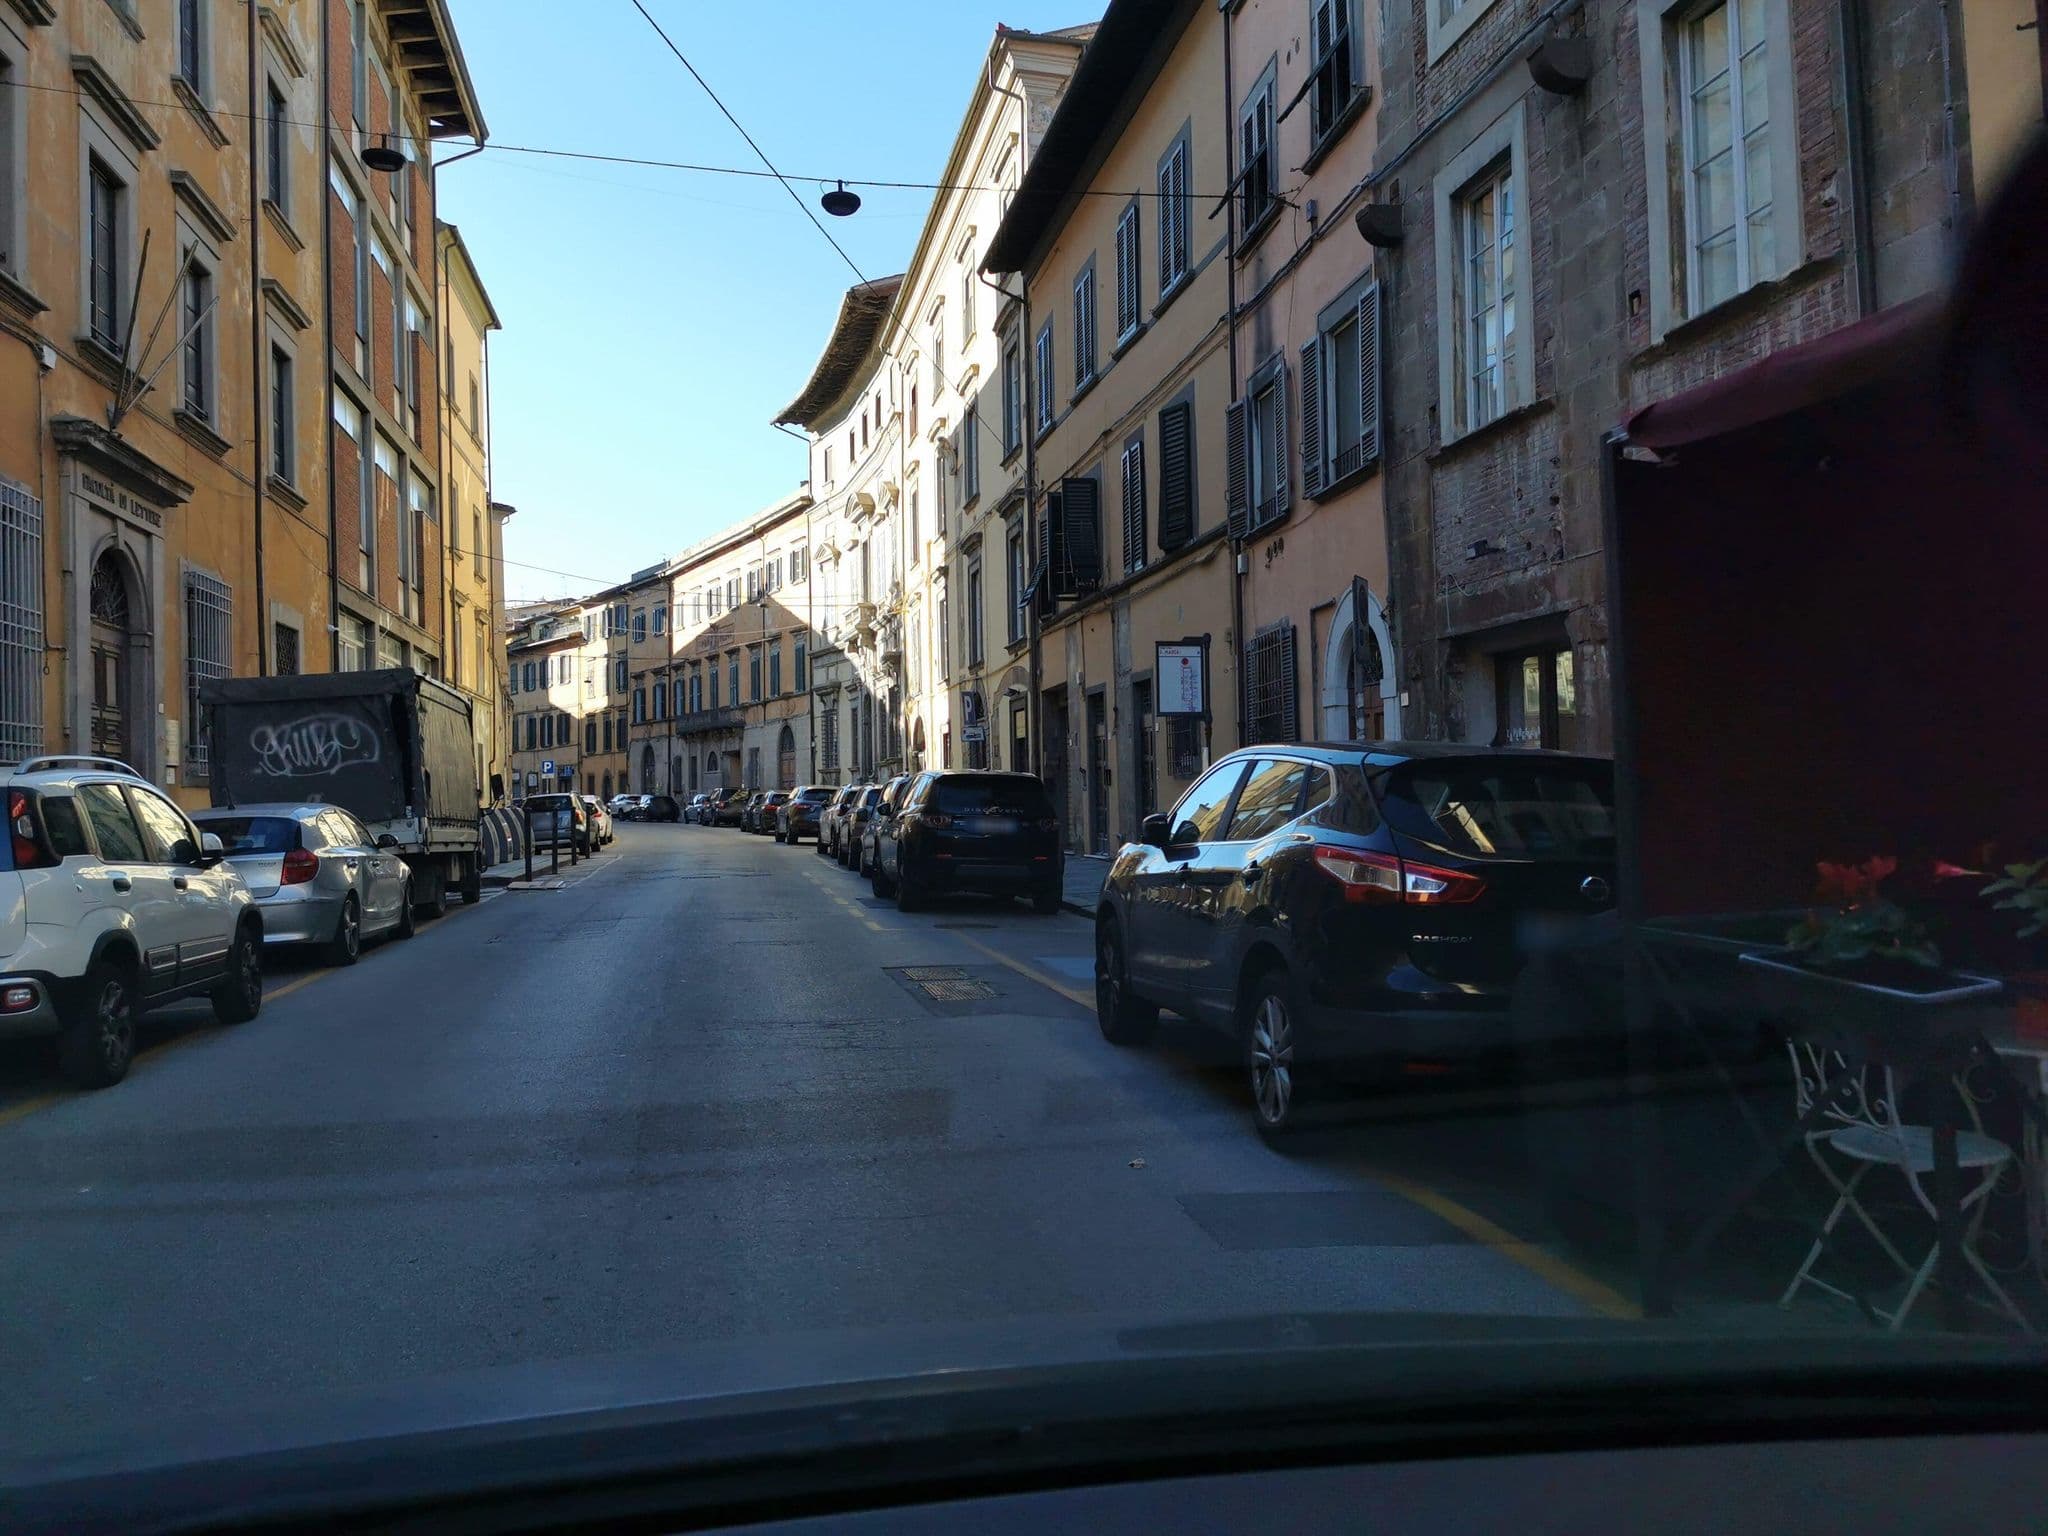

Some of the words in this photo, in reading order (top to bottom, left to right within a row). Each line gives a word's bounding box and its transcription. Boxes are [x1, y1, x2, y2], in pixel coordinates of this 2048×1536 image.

[119, 493, 127, 510] DI
[130, 499, 161, 528] LETTERE
[963, 694, 973, 721] P
[543, 761, 552, 773] P
